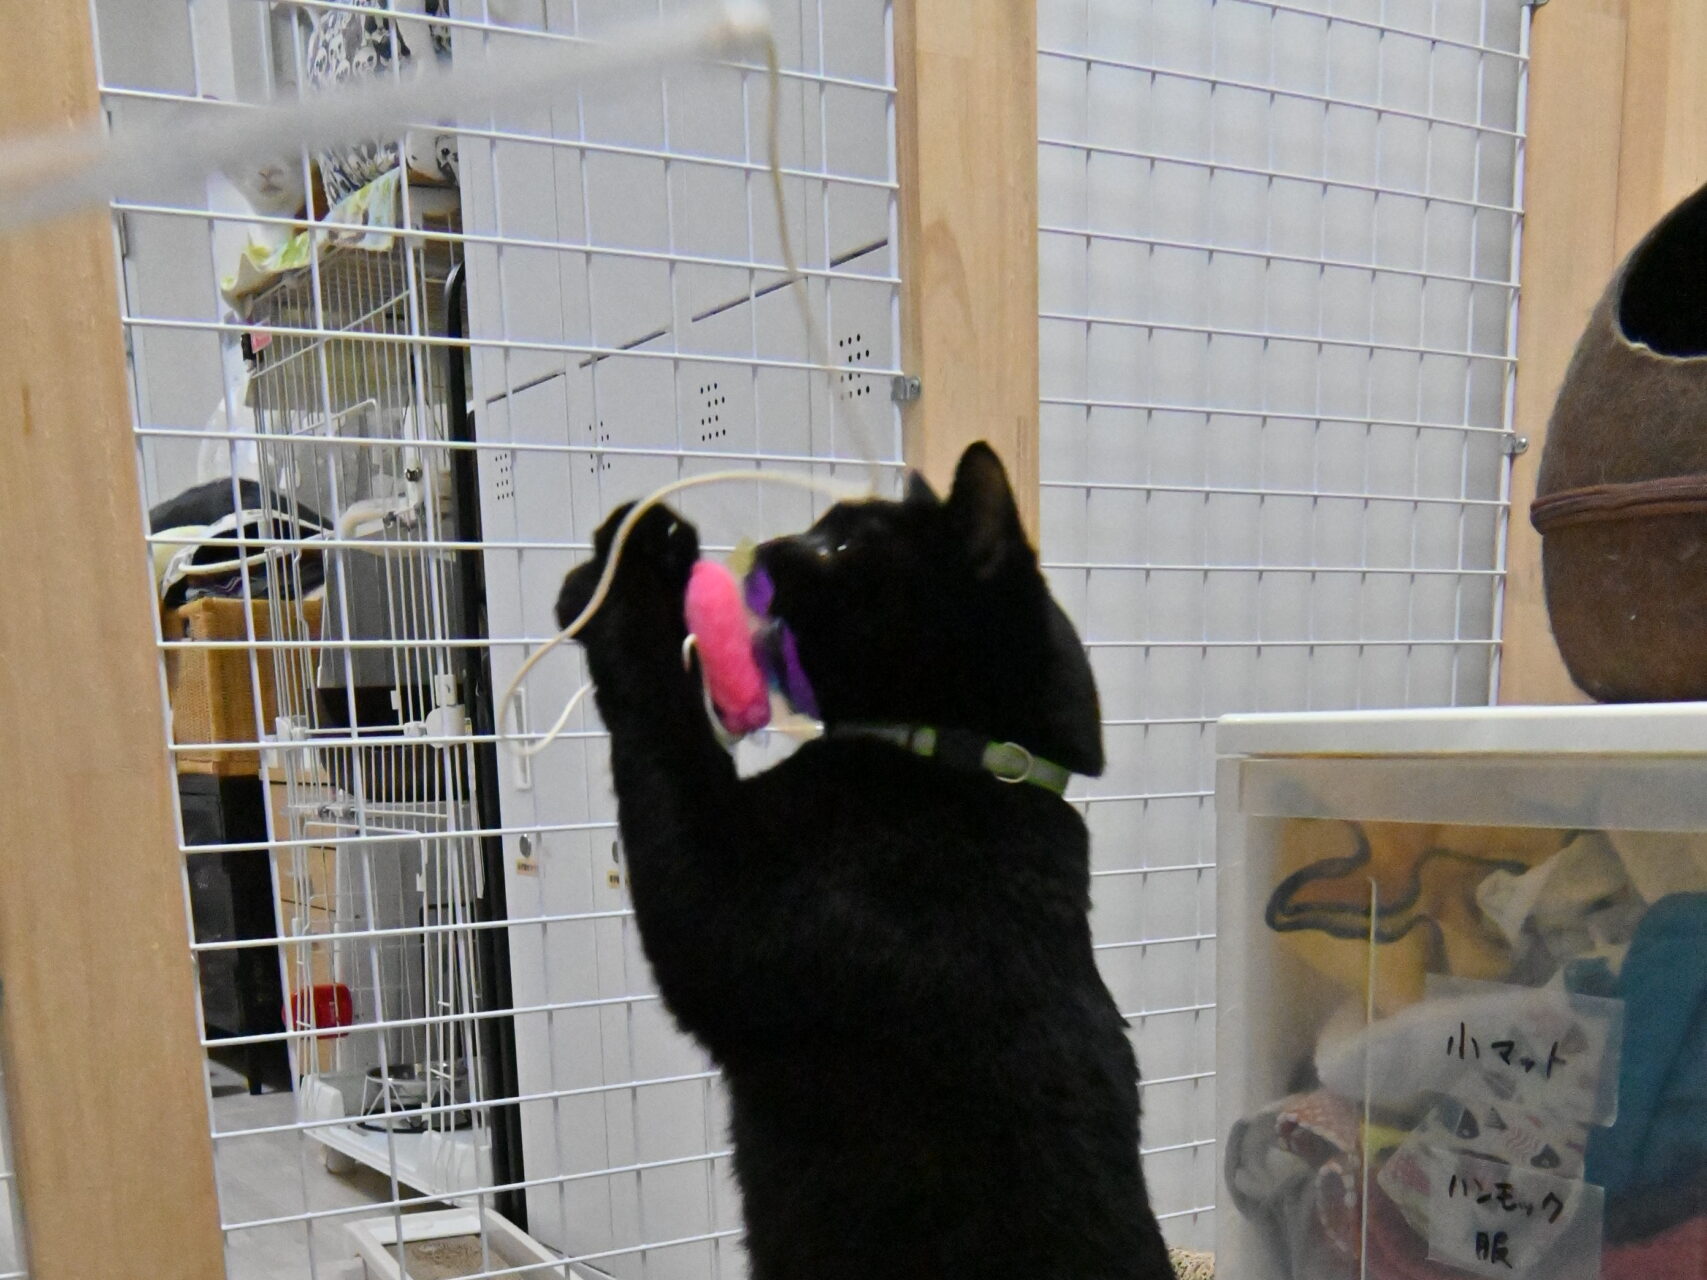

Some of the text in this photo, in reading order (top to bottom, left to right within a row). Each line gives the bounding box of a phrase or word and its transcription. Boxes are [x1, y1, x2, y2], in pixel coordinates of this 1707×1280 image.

[1448, 1174, 1564, 1224] ハンモック
[1475, 1230, 1513, 1269] 服
